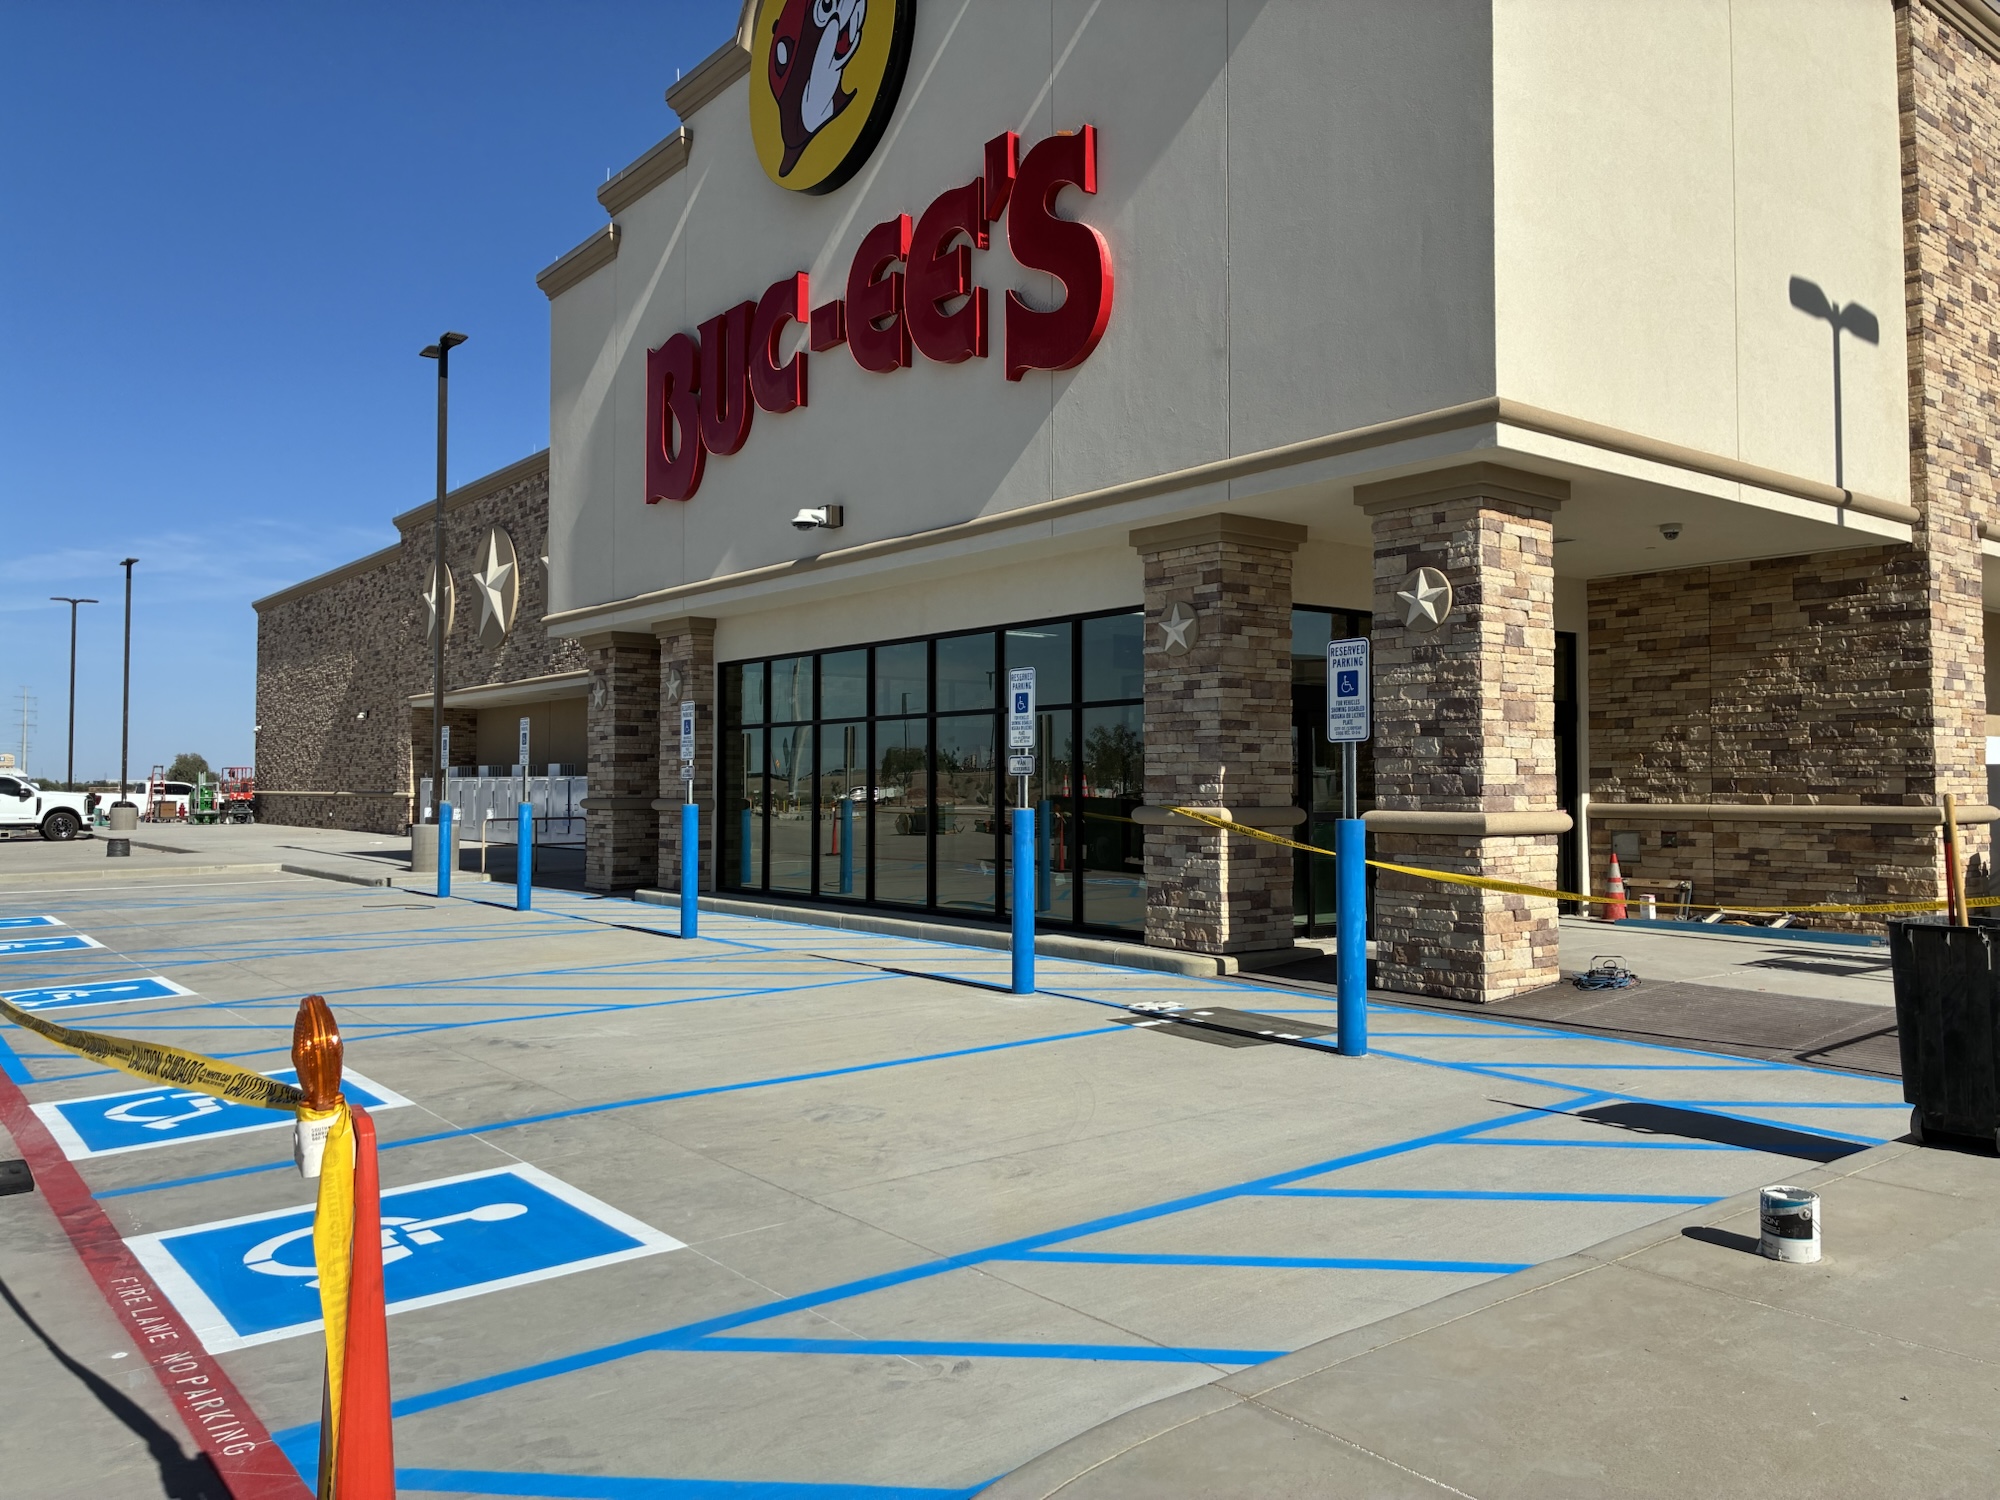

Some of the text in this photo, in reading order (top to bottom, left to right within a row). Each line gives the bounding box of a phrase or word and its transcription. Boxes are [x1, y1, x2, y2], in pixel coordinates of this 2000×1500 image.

[1330, 644, 1365, 657] RESERVED
[1332, 656, 1363, 668] PARKING
[1011, 673, 1033, 681] RESERVED
[1012, 681, 1032, 691] PARKING
[1017, 759, 1026, 767] VAN
[128, 1045, 206, 1085] CAUTION CUIDADO
[205, 1069, 232, 1083] WHITE CAP
[110, 1276, 255, 1456] FIRE LANE NO PARKING
